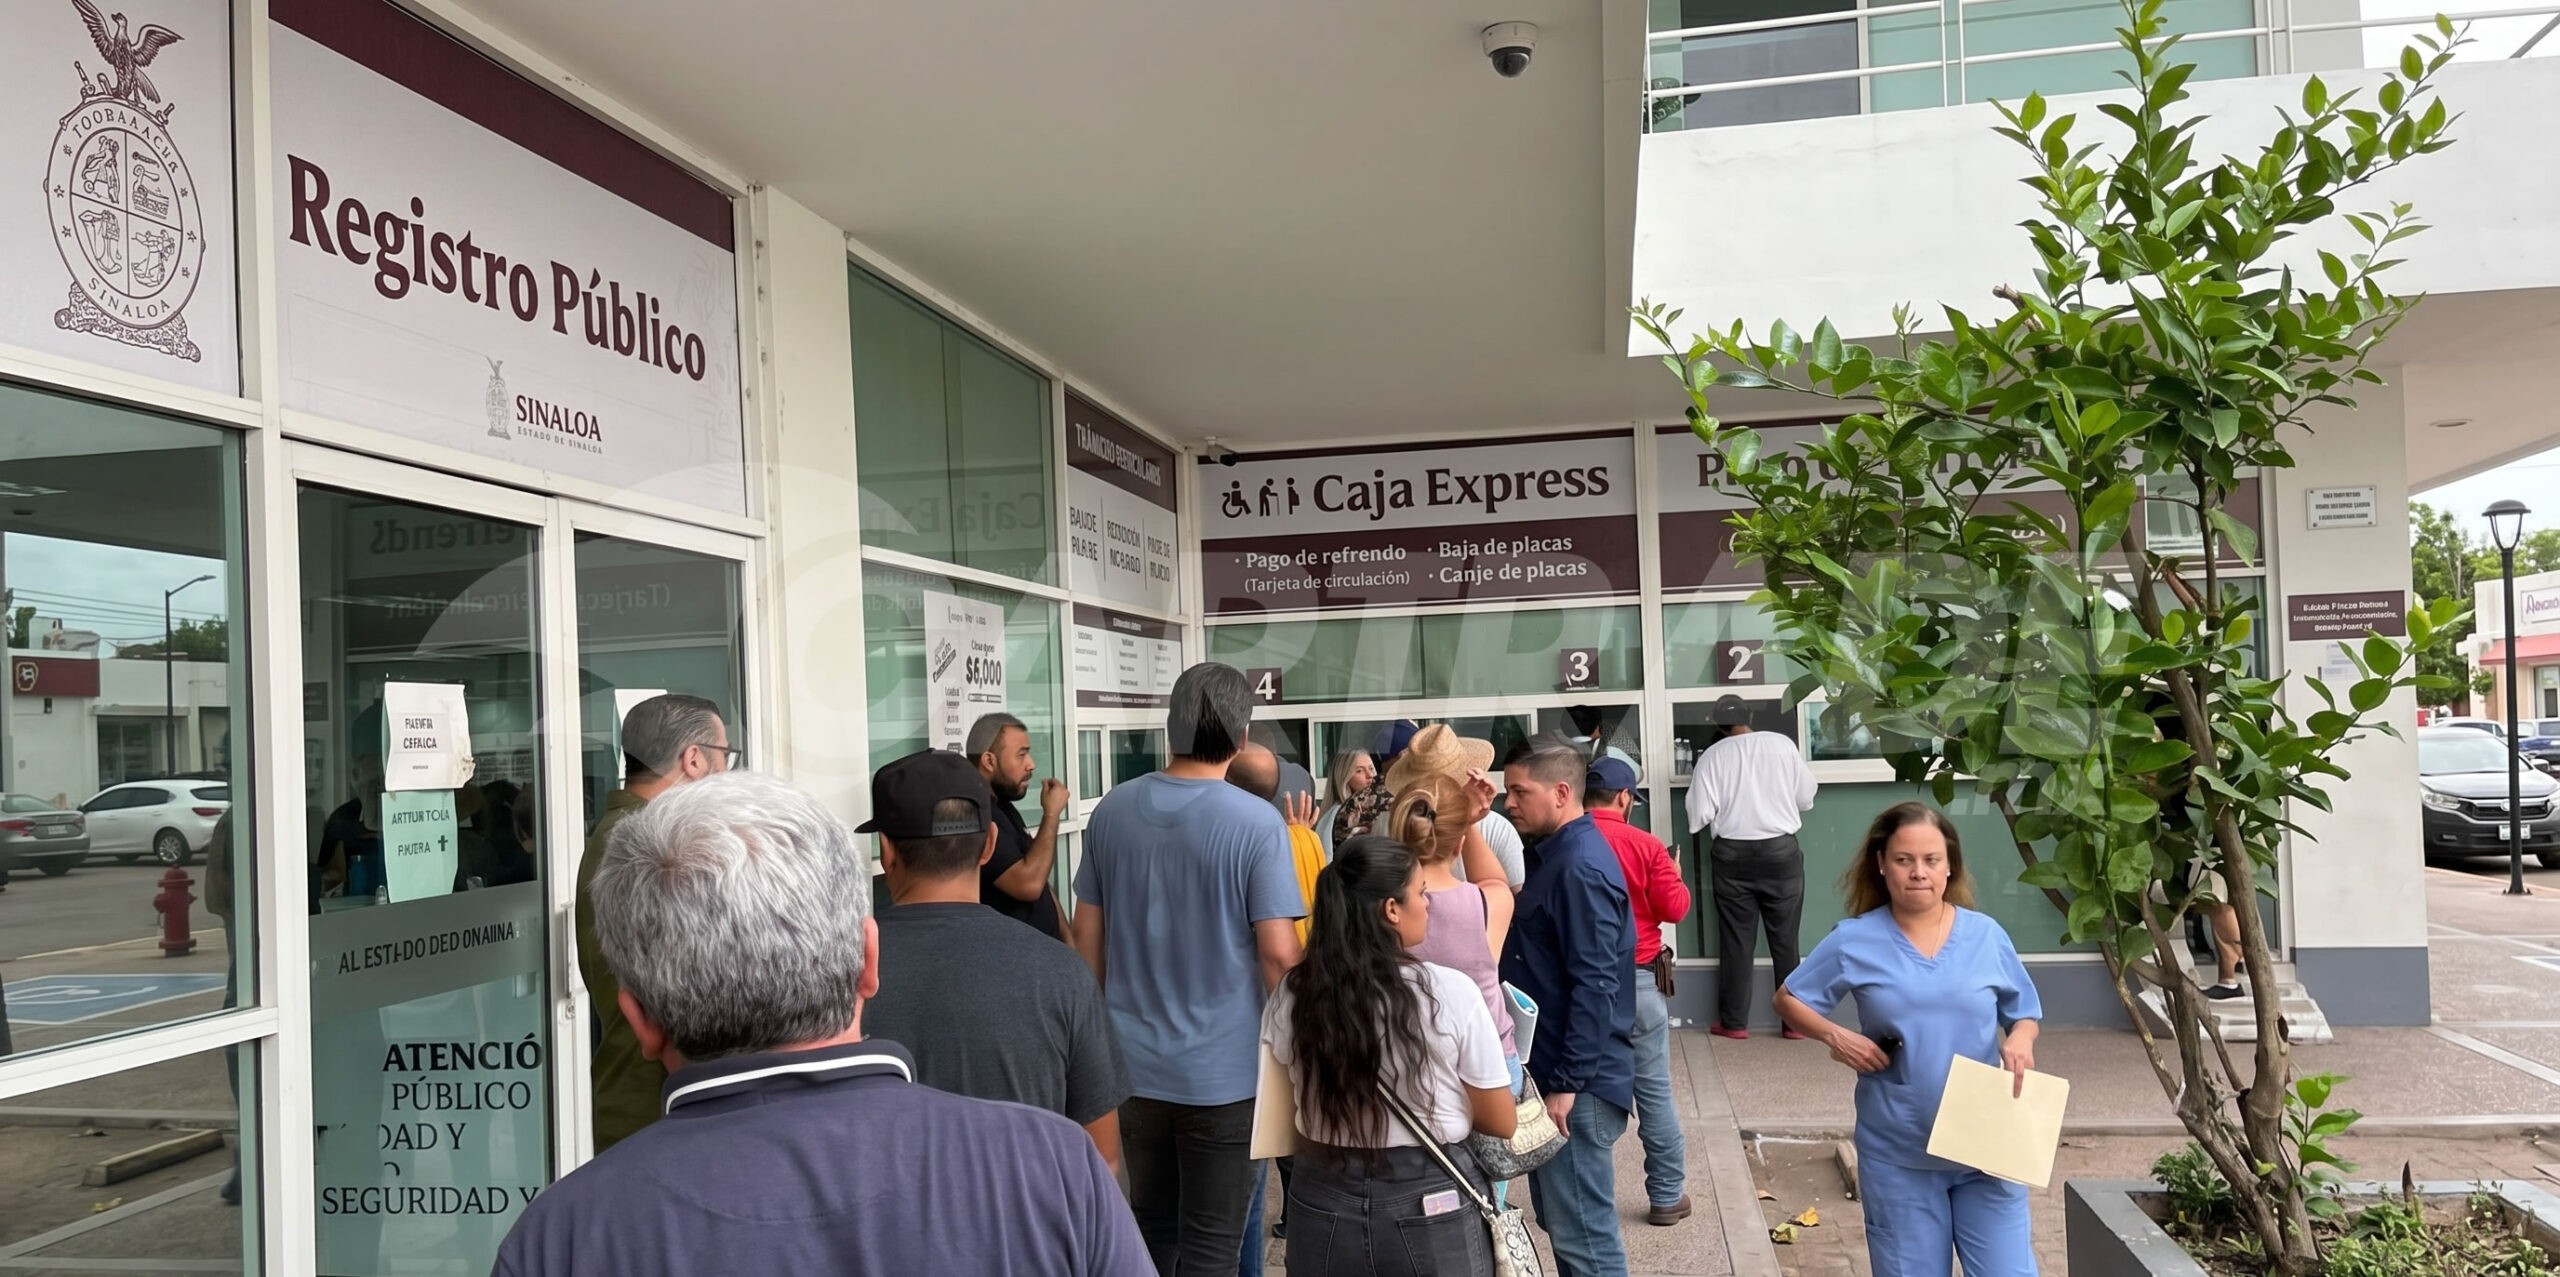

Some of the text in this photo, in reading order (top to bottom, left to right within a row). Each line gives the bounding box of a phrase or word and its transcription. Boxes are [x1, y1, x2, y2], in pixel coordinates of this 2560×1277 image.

[287, 153, 706, 382] Registro Público
[88, 277, 171, 319] SINALOA
[516, 394, 602, 442] SINALOA
[518, 426, 603, 454] ESTADO DE SINALOA
[1313, 464, 1611, 521] Caja Express
[1245, 545, 1407, 573] Pago de refrendo
[1439, 536, 1573, 561] Baja de placas
[1244, 570, 1410, 594] (Tarjeta de circulación)
[1439, 559, 1587, 585] Canje de placas
[966, 655, 1002, 689] $6,000
[1569, 651, 1590, 682] 3
[1727, 646, 1754, 680] 2
[1254, 671, 1276, 700] 4
[338, 950, 360, 974] AL
[429, 931, 460, 956] DED
[382, 1033, 543, 1072] ATENCIÓ
[391, 1076, 531, 1110] PÚBLICO
[446, 1123, 467, 1150] Y
[322, 1186, 509, 1214] SEGURIDAD
